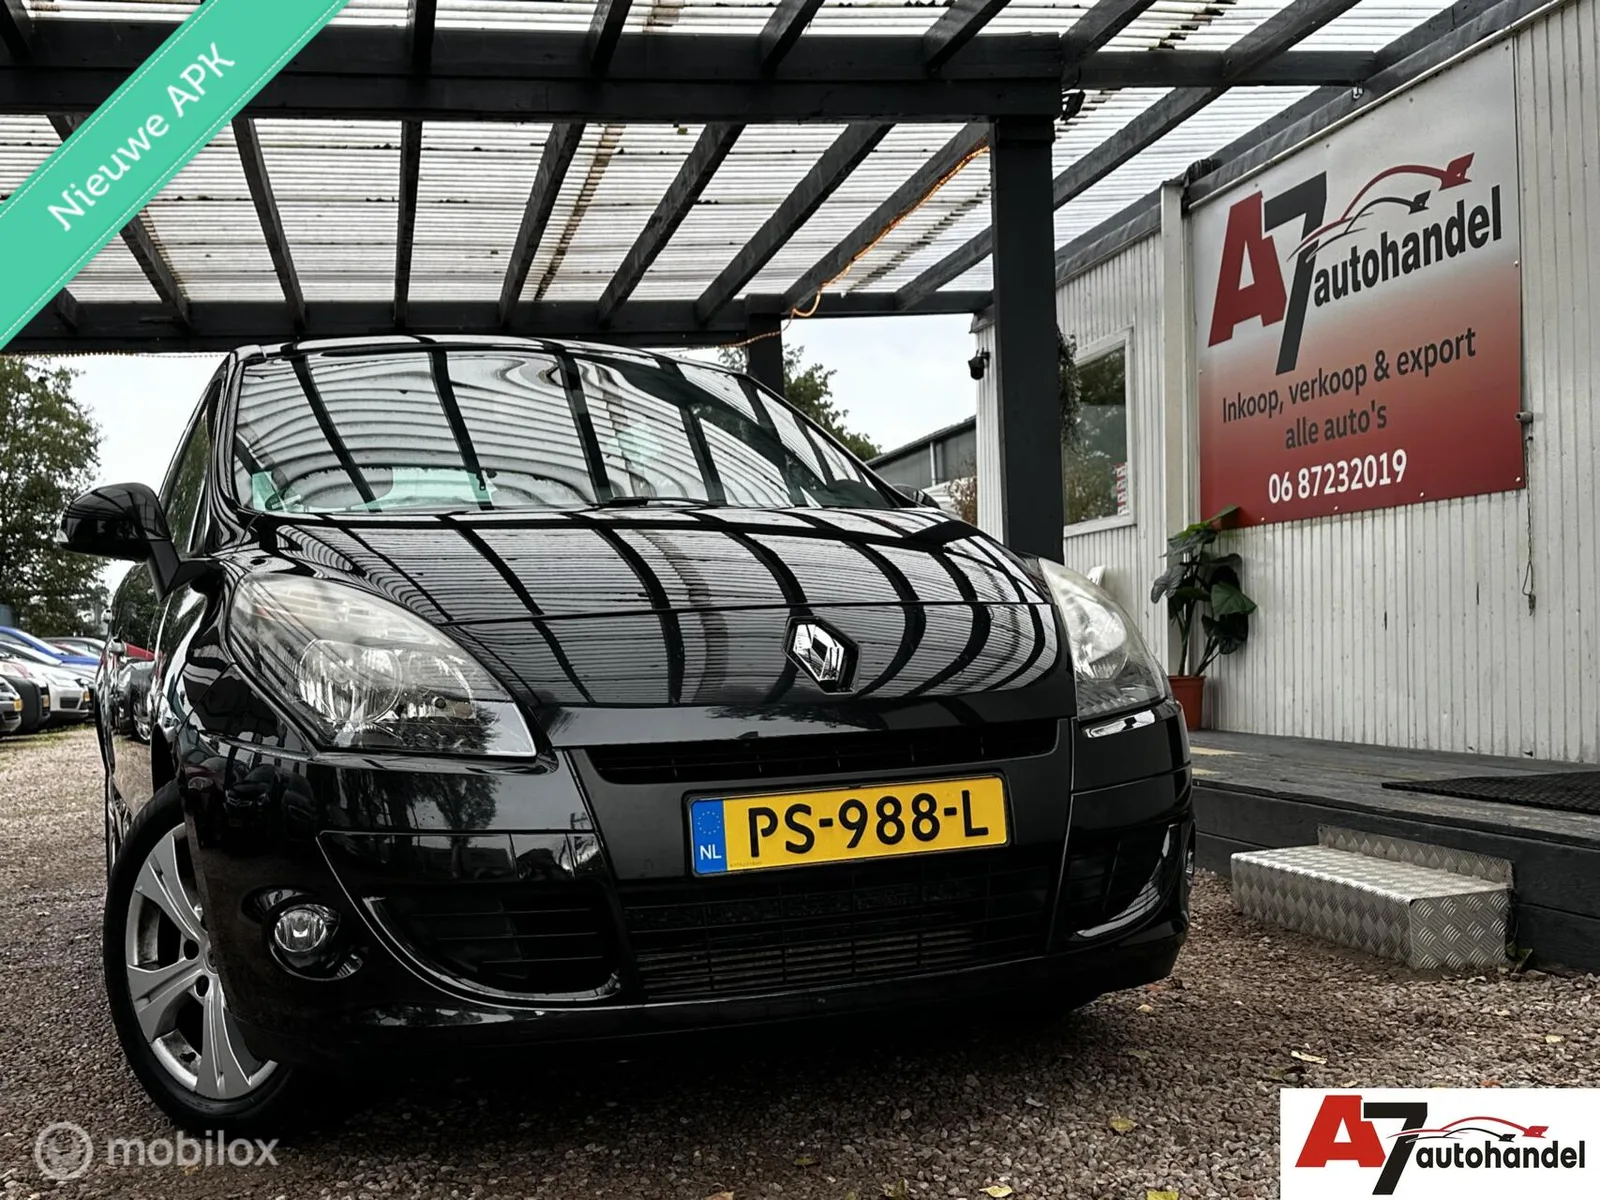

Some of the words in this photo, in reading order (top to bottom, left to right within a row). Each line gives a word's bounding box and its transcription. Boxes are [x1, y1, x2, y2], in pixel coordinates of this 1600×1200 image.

[1207, 171, 1327, 376] A7
[1313, 185, 1502, 307] autohandel
[1222, 386, 1284, 423] Inkoop,
[1288, 361, 1368, 405] verkoop
[1374, 350, 1390, 382] &
[1397, 327, 1476, 377] export
[1285, 418, 1319, 449] alle
[1324, 400, 1388, 438] auto's
[1268, 471, 1293, 504] 06
[1298, 449, 1408, 499] 87232019
[700, 844, 722, 861] NL
[748, 789, 989, 858] PS-988-L
